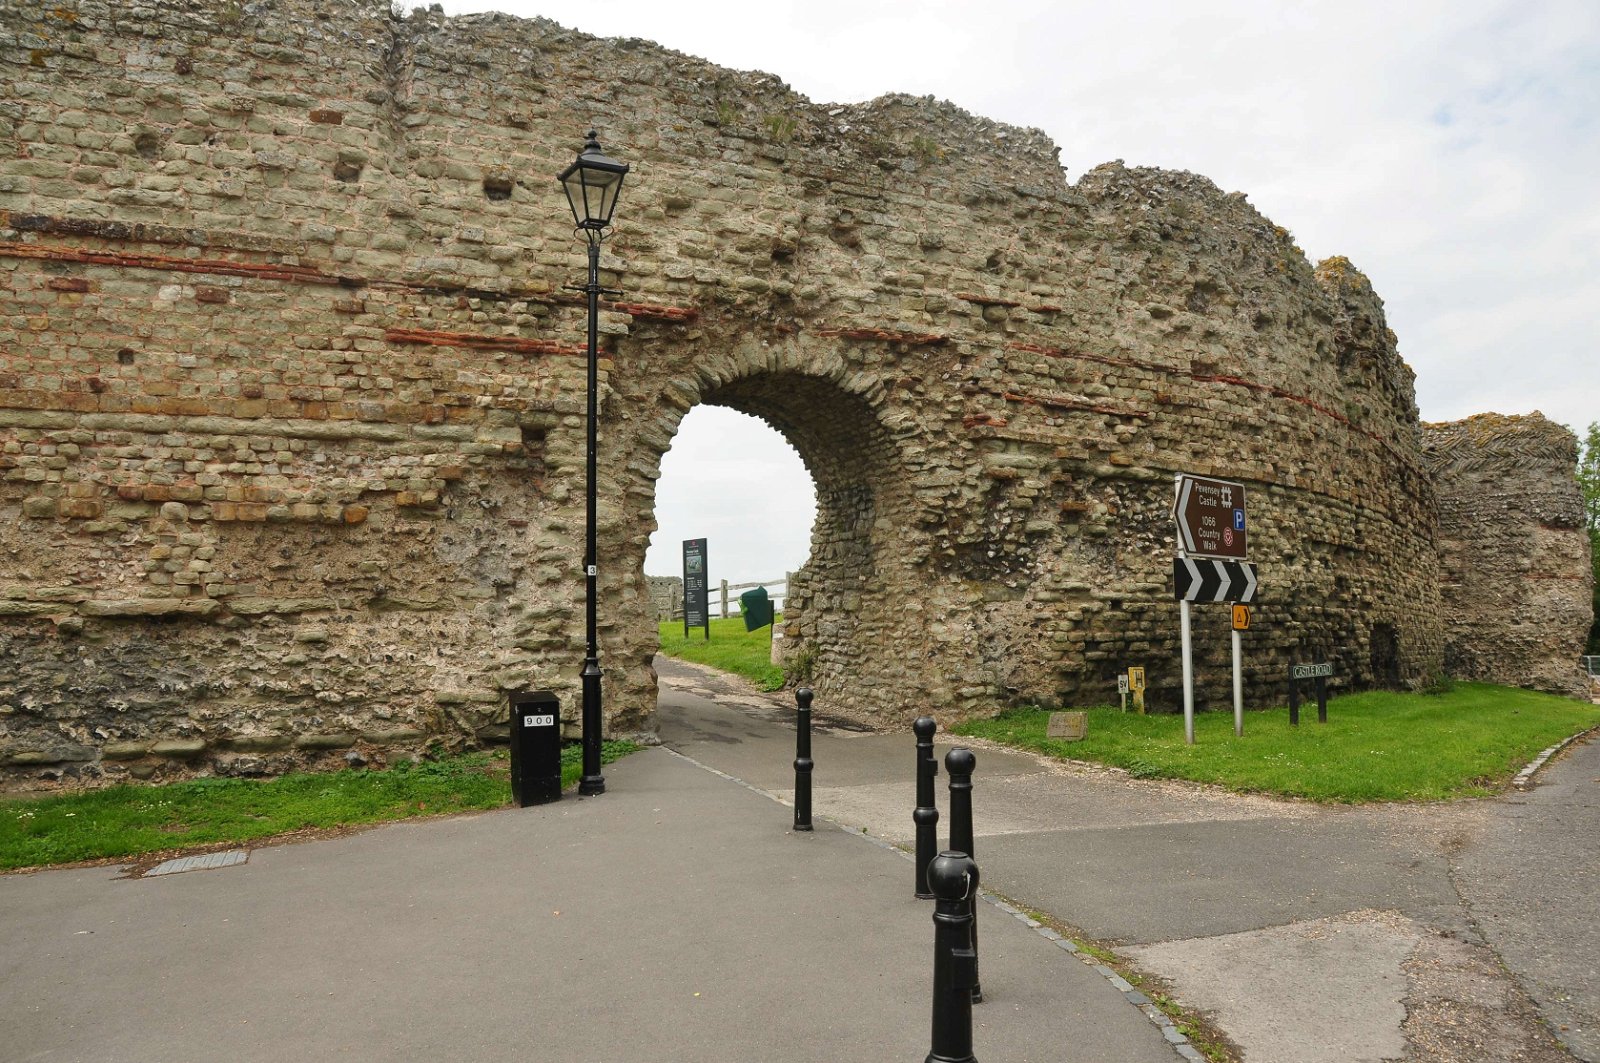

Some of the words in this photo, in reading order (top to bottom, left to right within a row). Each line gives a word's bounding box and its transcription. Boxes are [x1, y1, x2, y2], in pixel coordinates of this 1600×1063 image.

[1195, 482, 1220, 497] Pevensey
[1199, 495, 1217, 507] Castle
[1202, 516, 1216, 527] 1066
[1236, 512, 1242, 528] P
[1198, 528, 1220, 540] Country
[1203, 540, 1217, 551] Walk
[1295, 666, 1316, 678] CASTLE
[1315, 664, 1331, 676] ROAD
[1120, 680, 1127, 688] SV
